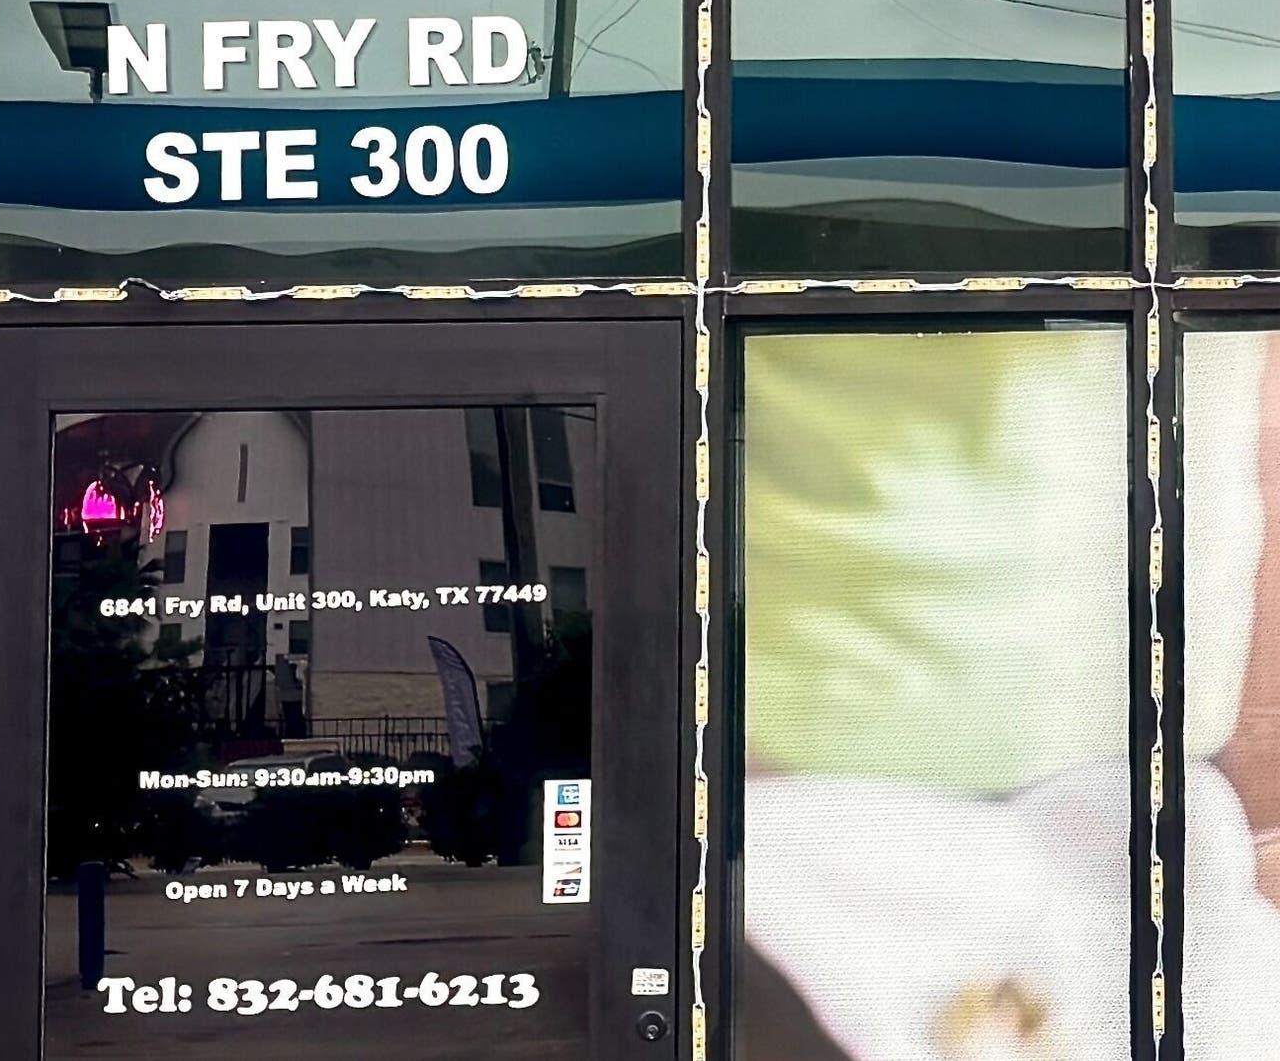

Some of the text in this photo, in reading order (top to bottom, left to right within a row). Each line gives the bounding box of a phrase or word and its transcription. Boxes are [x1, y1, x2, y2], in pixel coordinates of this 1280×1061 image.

[107, 16, 528, 94] N FRY RD
[143, 123, 509, 203] STE 300
[100, 584, 547, 618] 6841 Fry Rd, Unit 300, Katy, TX 77449
[139, 769, 248, 789] Mon-Sun:
[165, 873, 408, 904] Open 7 Days a Week
[97, 971, 540, 1015] Tel: 832-681-6213
